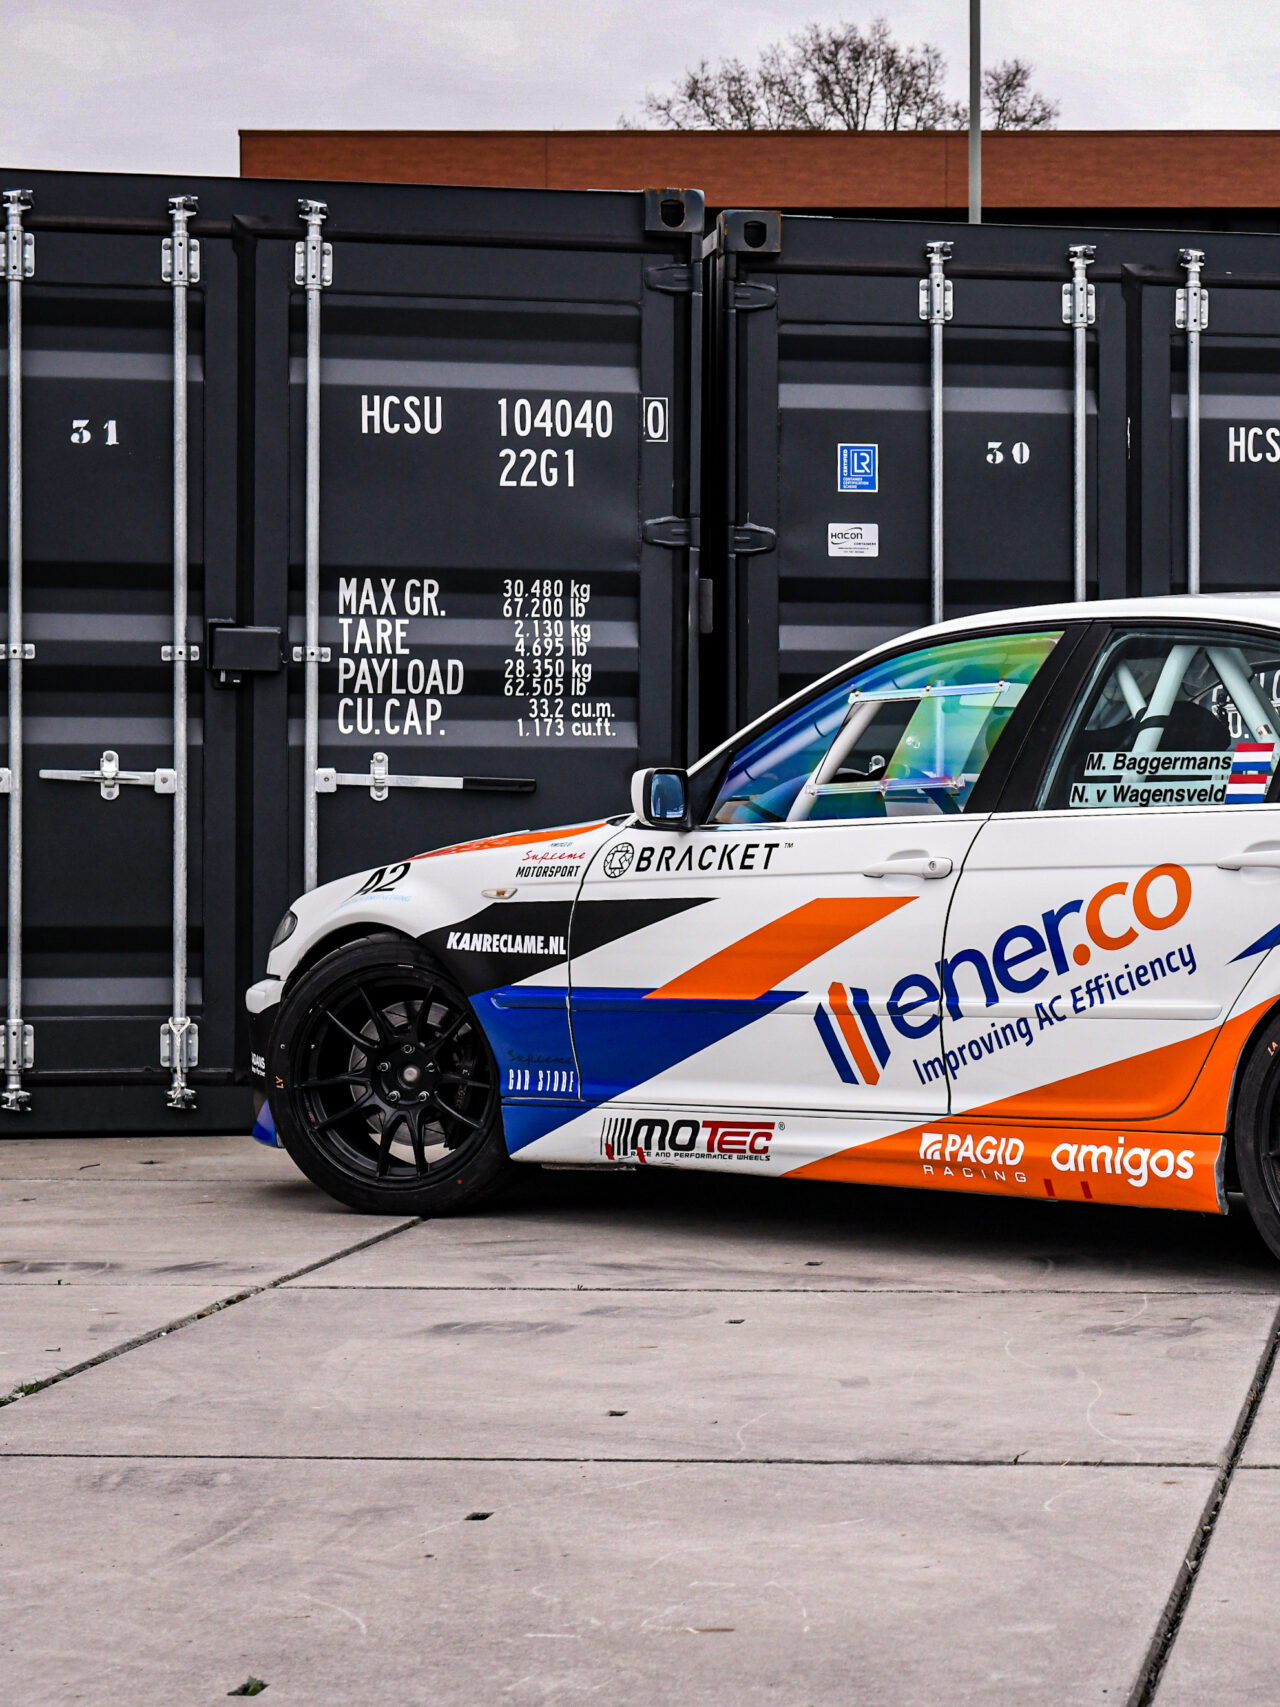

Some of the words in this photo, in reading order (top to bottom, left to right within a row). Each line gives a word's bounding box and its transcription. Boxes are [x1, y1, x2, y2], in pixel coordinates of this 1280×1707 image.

[361, 395, 442, 434] HCSU
[498, 398, 613, 437] 104040
[647, 401, 664, 438] 0
[499, 449, 574, 487] 22G1
[854, 452, 870, 473] LR
[338, 577, 397, 615] MAX
[404, 579, 446, 617] GR.
[503, 579, 563, 598] 30,480
[570, 579, 591, 603] kg
[503, 598, 563, 618] 67,200
[570, 598, 586, 618] lb
[338, 618, 410, 655] TARE
[514, 619, 564, 638] 2,130
[570, 619, 591, 643] kg
[515, 637, 564, 657] 4,695
[571, 637, 587, 657] lb
[338, 658, 465, 695] PAYLOAD
[504, 659, 565, 678] 28,350
[571, 659, 592, 683] kg
[504, 678, 564, 696] 62,505
[571, 678, 587, 696] lb
[528, 698, 564, 718] 33.2
[571, 702, 616, 718] cu.m.
[517, 718, 565, 737] 1,173
[571, 718, 617, 737] cu.ft.
[1086, 753, 1106, 771] M.
[1113, 753, 1232, 775] Baggermans
[1071, 785, 1089, 803] N.
[1096, 789, 1107, 803] v
[1113, 784, 1227, 807] Wagensveld
[522, 850, 587, 864] Supreme
[635, 843, 780, 872] BRACKET
[515, 865, 581, 878] MOTORSPORT
[446, 931, 567, 955] KANRECLAME.NL
[886, 862, 1192, 1039] ener.co
[913, 1016, 1033, 1085] Improving
[1034, 995, 1067, 1031] AC
[1070, 943, 1197, 1014] Efficiency
[508, 1068, 530, 1091] CAR
[537, 1070, 574, 1093] STORE
[674, 1152, 733, 1160] PERFORMANCE
[736, 1154, 771, 1162] WHEELS
[945, 1133, 1025, 1166] PAGID
[922, 1164, 1027, 1183] RACING
[1050, 1136, 1196, 1188] amigos
